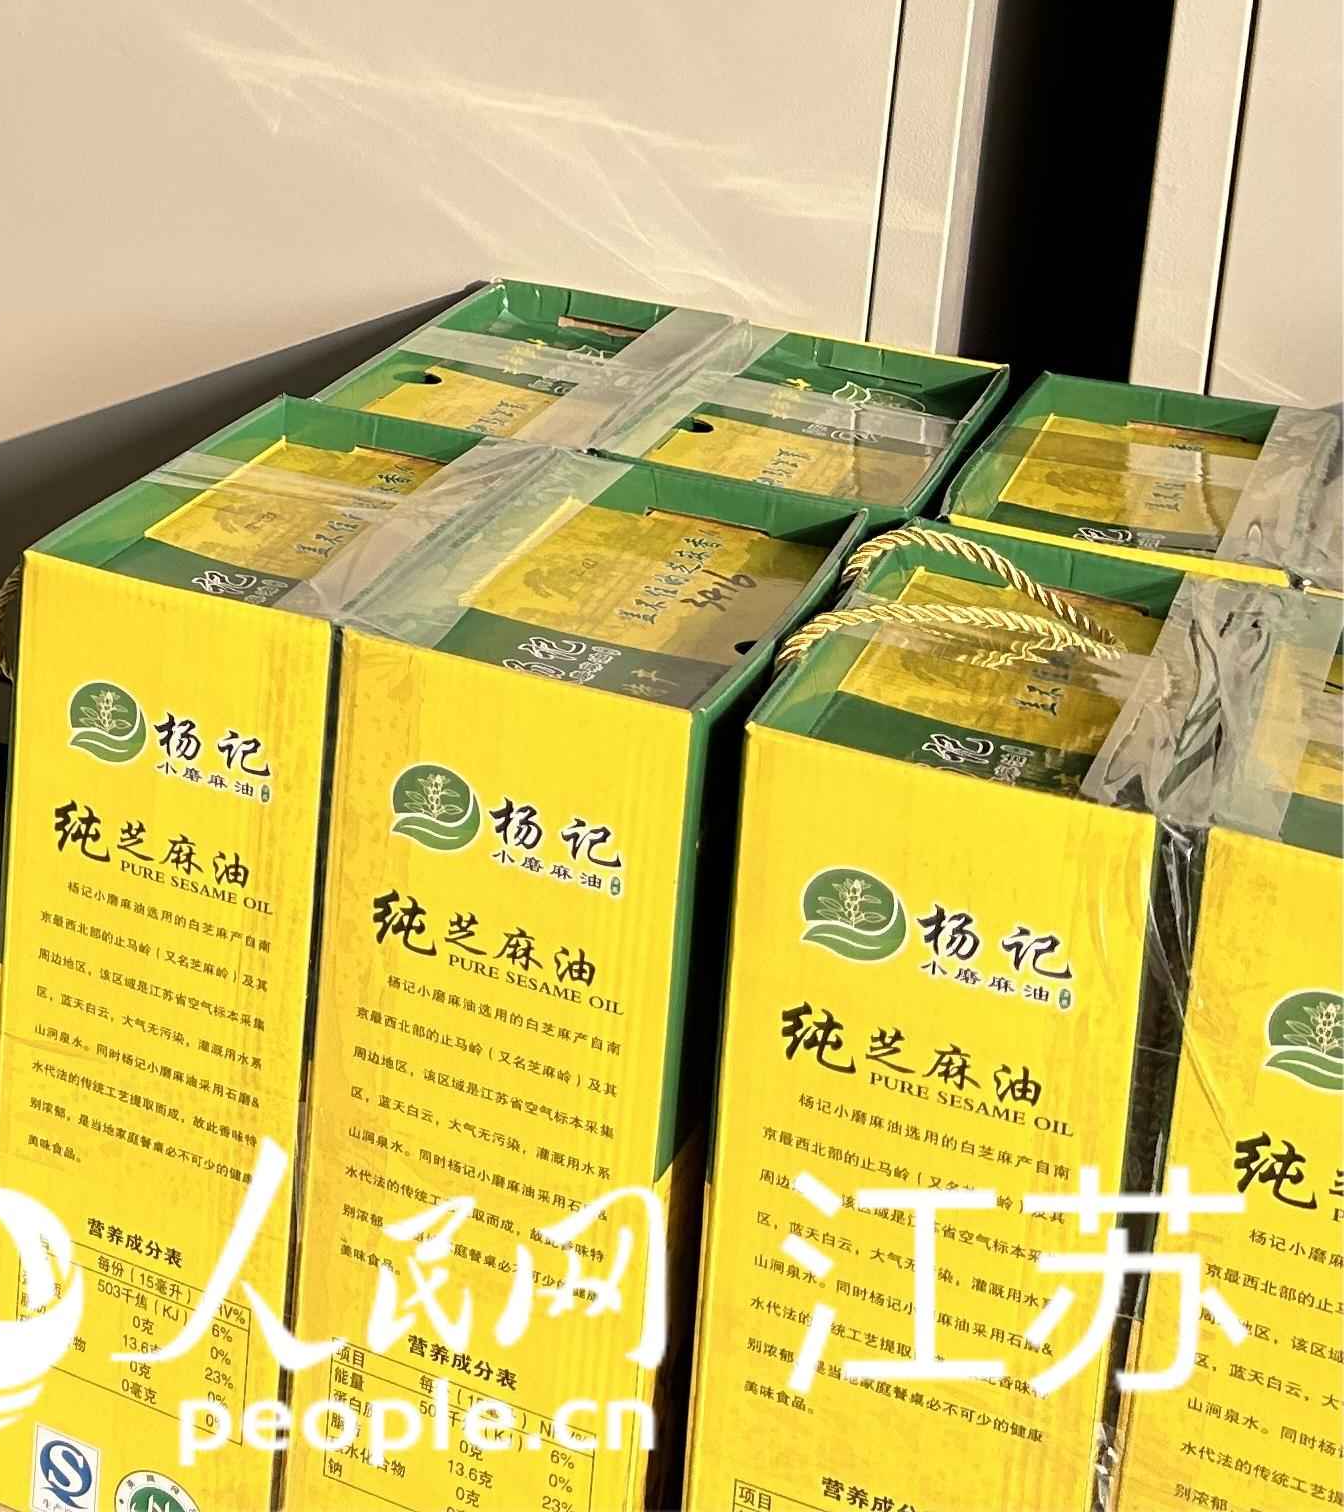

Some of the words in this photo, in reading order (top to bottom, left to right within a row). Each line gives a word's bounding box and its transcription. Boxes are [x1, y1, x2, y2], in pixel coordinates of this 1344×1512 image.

[154, 712, 270, 777] 杨记
[157, 761, 254, 797] 小磨麻油
[54, 800, 250, 889] 纯芝麻油
[489, 798, 621, 868] 杨记
[120, 859, 165, 884] PURE
[170, 875, 237, 905] SESAME
[243, 896, 273, 915] OIL
[492, 849, 602, 890] 小磨麻油
[373, 889, 596, 987] 纯芝麻油
[917, 904, 1073, 979] 杨记
[448, 953, 499, 980] PURE
[505, 971, 582, 1004] SESAME
[588, 995, 624, 1016] OIL
[920, 960, 1049, 1003] 小磨麻油
[781, 1001, 1043, 1107] 纯芝麻油
[869, 1071, 930, 1101] PURE
[937, 1090, 1026, 1126] SESAME
[1034, 1116, 1075, 1138] OIL
[87, 1217, 184, 1269] 营养成分表
[132, 1316, 154, 1335] 0克
[210, 1346, 232, 1366] 0%
[212, 1324, 233, 1343] 6%
[130, 1360, 152, 1380] 0克
[205, 1367, 234, 1389] 23%
[333, 1366, 365, 1392] 能量
[407, 1334, 518, 1391] 营养成分表
[121, 1379, 158, 1405] 0毫克
[327, 1457, 343, 1478] 钠
[455, 1486, 480, 1509] 0克
[447, 1459, 493, 1490] 13.6克
[548, 1474, 573, 1494] 0%
[550, 1450, 575, 1470] 6%
[738, 1486, 772, 1511] 项目
